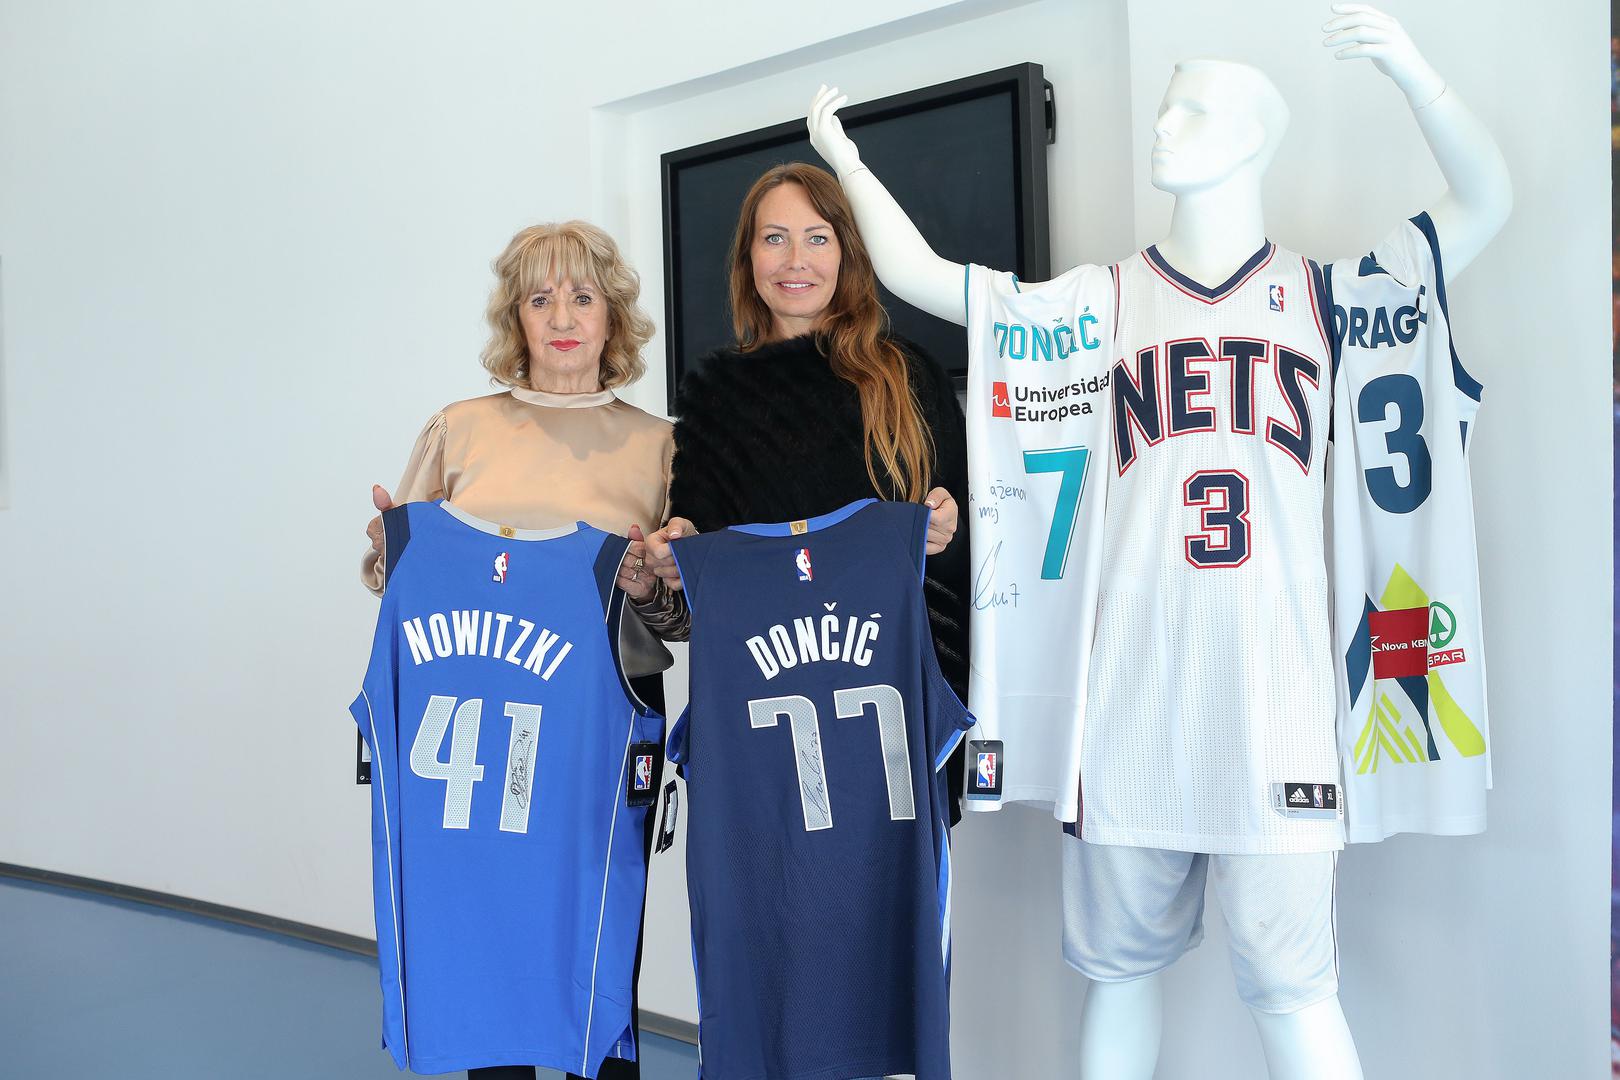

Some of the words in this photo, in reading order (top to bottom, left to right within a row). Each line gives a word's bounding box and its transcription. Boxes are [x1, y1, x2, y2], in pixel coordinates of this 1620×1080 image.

[1015, 370, 1110, 402] Universidad
[1015, 401, 1093, 422] Europea
[1111, 336, 1321, 477] NETS
[1357, 374, 1433, 514] 3
[1023, 445, 1092, 580] 7
[1183, 468, 1251, 569] 3
[402, 609, 574, 682] NOWITZKI
[746, 602, 882, 681] DONČIĆ
[1381, 642, 1408, 652] Nova
[1428, 651, 1464, 666] SPAR
[409, 695, 543, 834] 41
[748, 684, 916, 832] 77
